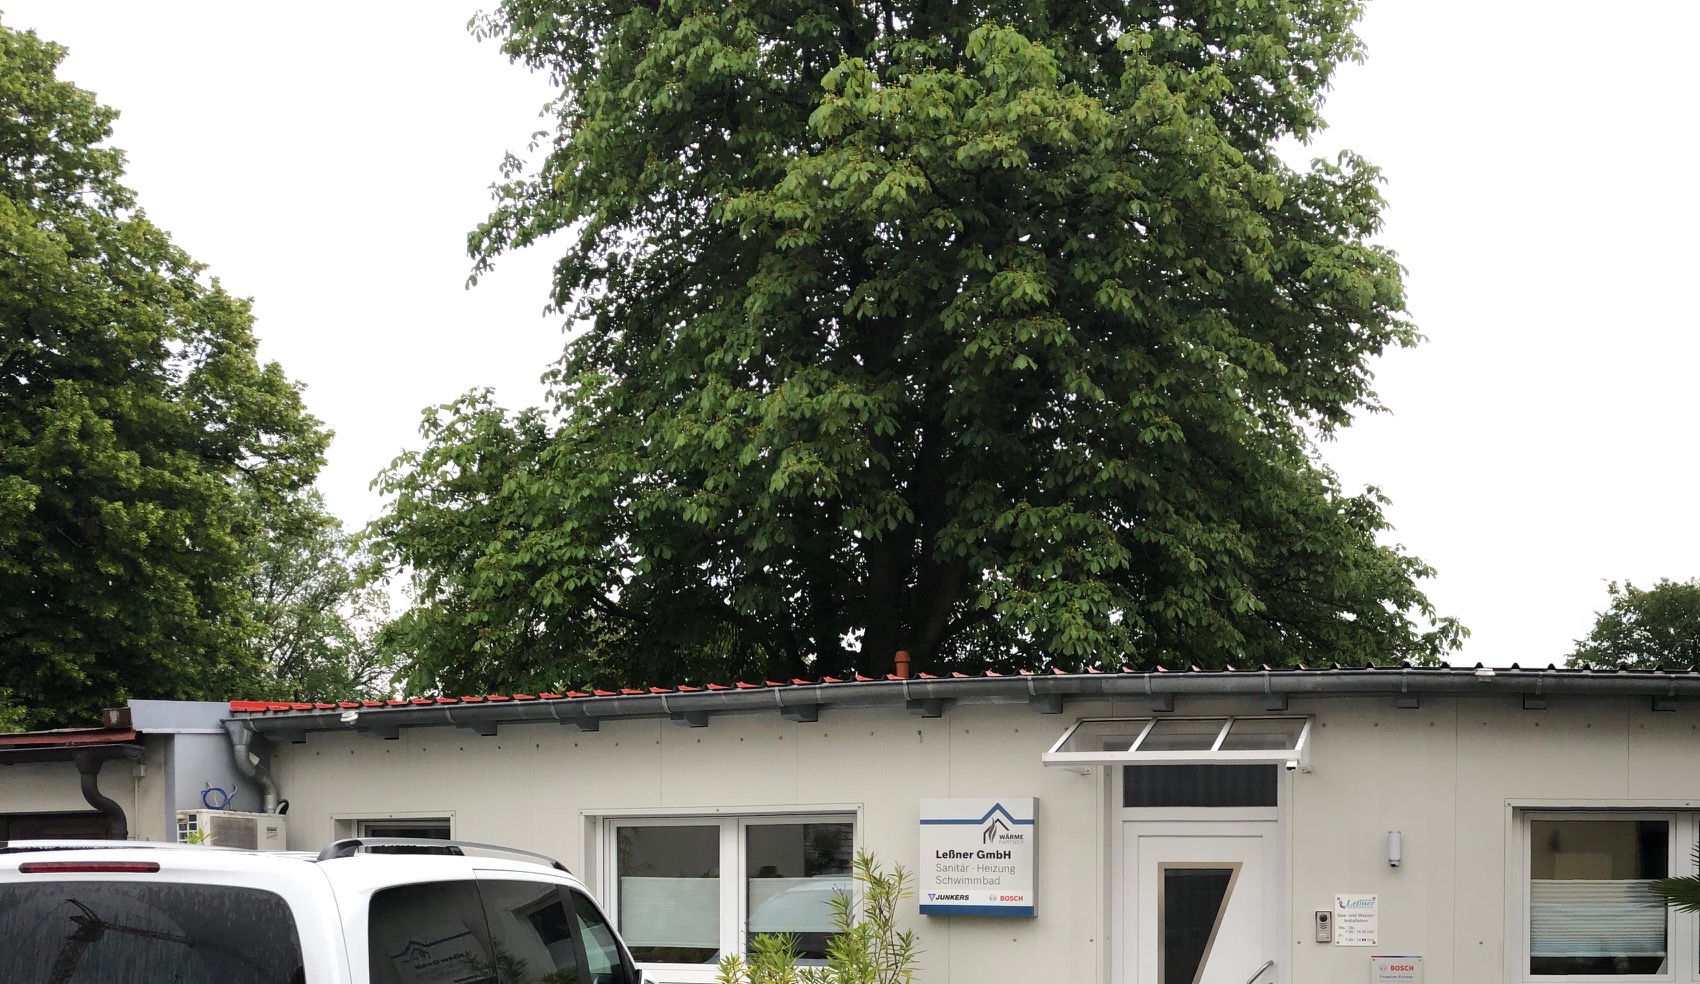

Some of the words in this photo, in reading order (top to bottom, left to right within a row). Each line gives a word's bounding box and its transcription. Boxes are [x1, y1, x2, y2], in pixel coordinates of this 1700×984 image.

[936, 850, 974, 859] Leßner
[976, 850, 1011, 859] GmbH
[936, 863, 969, 873] Sanitär
[976, 863, 1016, 875] Heizung
[936, 875, 1000, 885] Schwimmbad
